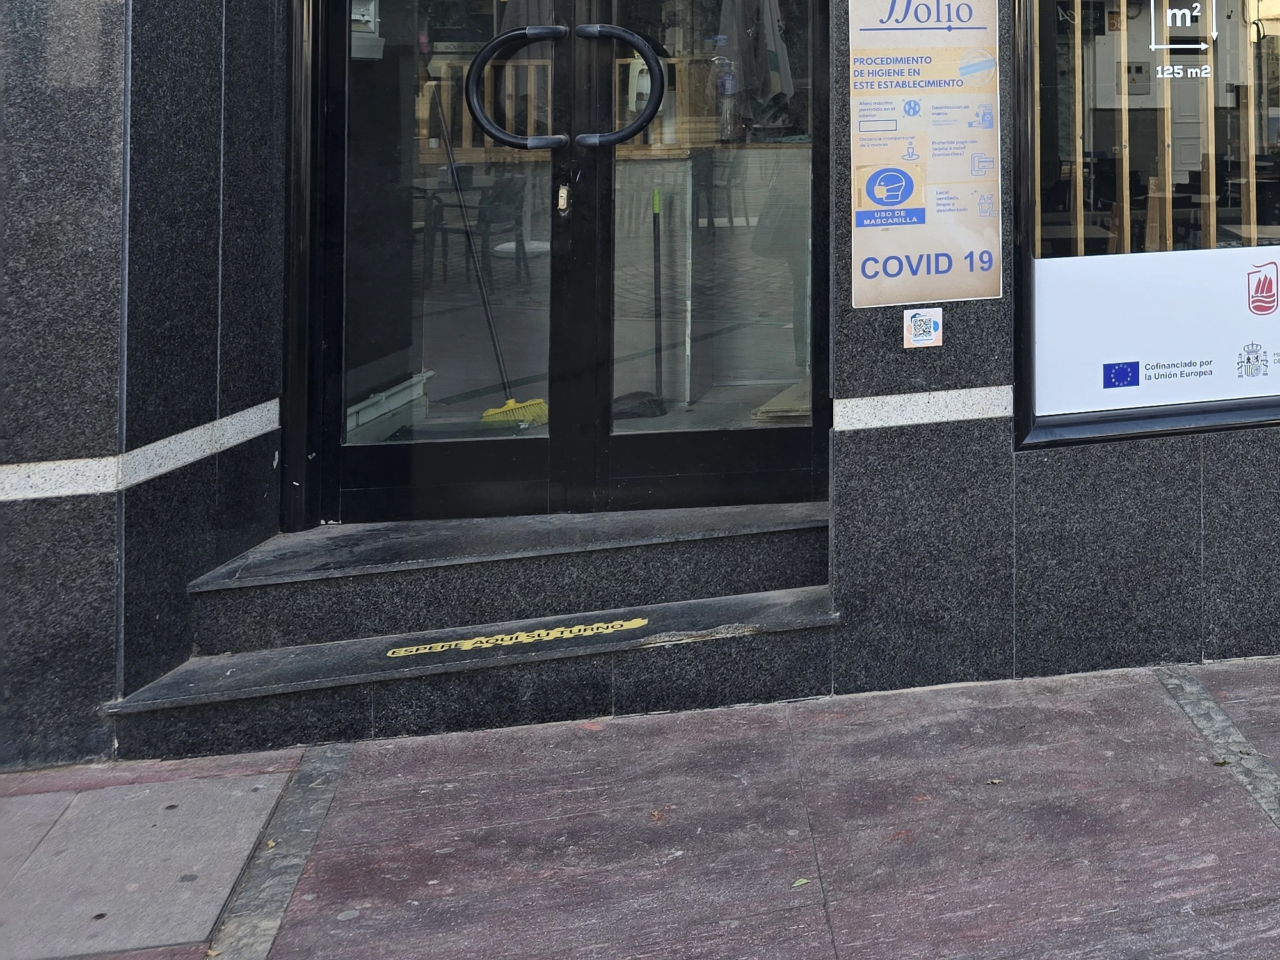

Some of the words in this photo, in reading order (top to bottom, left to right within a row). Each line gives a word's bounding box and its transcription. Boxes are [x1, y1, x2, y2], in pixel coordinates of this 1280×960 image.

[853, 56, 932, 66] PROCEDIMIENTO
[853, 69, 865, 78] DE
[867, 68, 906, 77] HIGIENE
[908, 68, 921, 77] EN
[1156, 66, 1184, 78] 125
[1187, 65, 1211, 78] m2
[853, 81, 875, 90] ESTE
[878, 79, 964, 89] ESTABLECIMIENTO
[864, 216, 918, 225] MASCARILLA
[860, 252, 953, 280] COVID
[964, 250, 994, 272] 19
[1144, 361, 1198, 371] Cofinanciado
[1199, 359, 1213, 369] por
[1144, 373, 1152, 381] la
[1154, 370, 1178, 380] Unión
[1180, 369, 1213, 379] Europea
[391, 642, 465, 655] ESPERE
[526, 632, 550, 640] SU
[557, 623, 624, 635] TURNO
